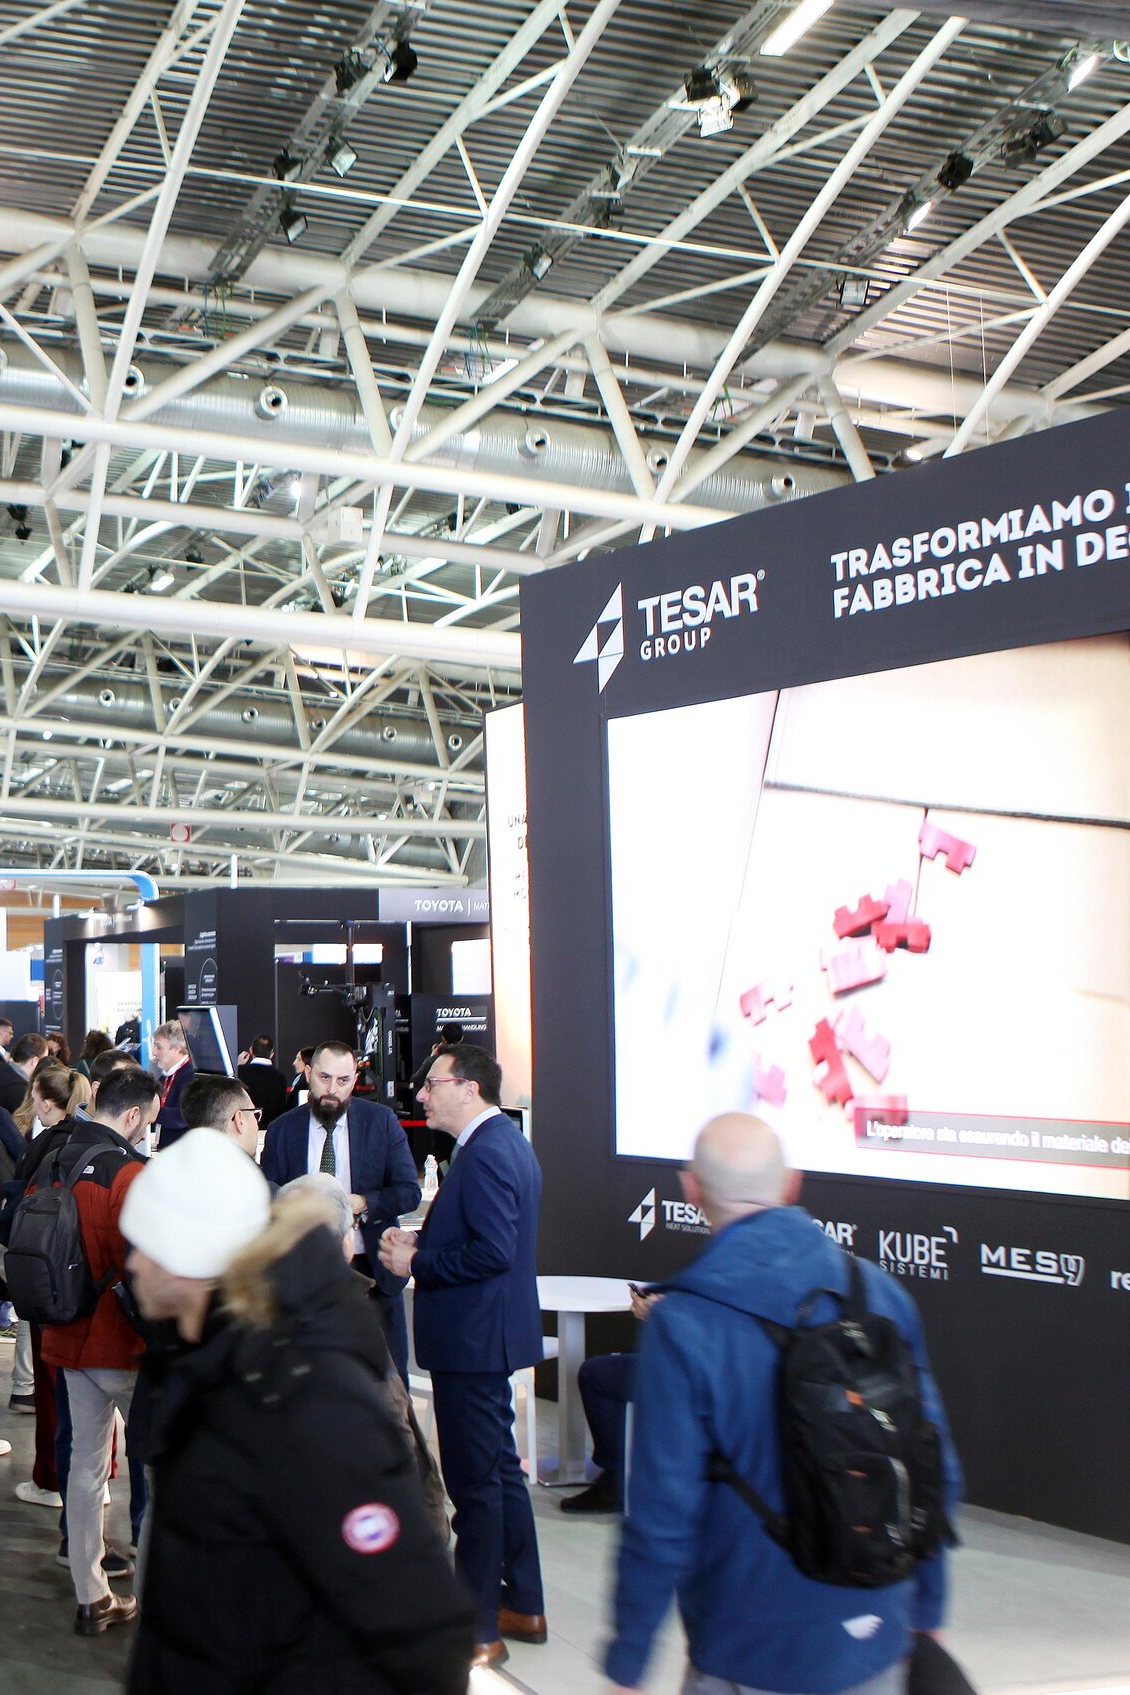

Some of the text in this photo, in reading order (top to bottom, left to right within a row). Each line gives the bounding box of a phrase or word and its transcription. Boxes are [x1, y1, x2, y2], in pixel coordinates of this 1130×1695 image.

[830, 489, 1115, 582] TRASFORMIAMO
[833, 525, 1130, 619] FABBRICA IN DE
[640, 627, 711, 661] GROUP
[414, 899, 464, 912] TOYOTA
[436, 1008, 471, 1017] TOYOTA
[866, 1120, 935, 1141] L'operatore
[937, 1126, 957, 1142] sta
[959, 1129, 1029, 1148] esaurendo
[1041, 1133, 1110, 1153] materiale
[879, 1230, 948, 1268] KUBE
[879, 1260, 949, 1281] SISTEMI
